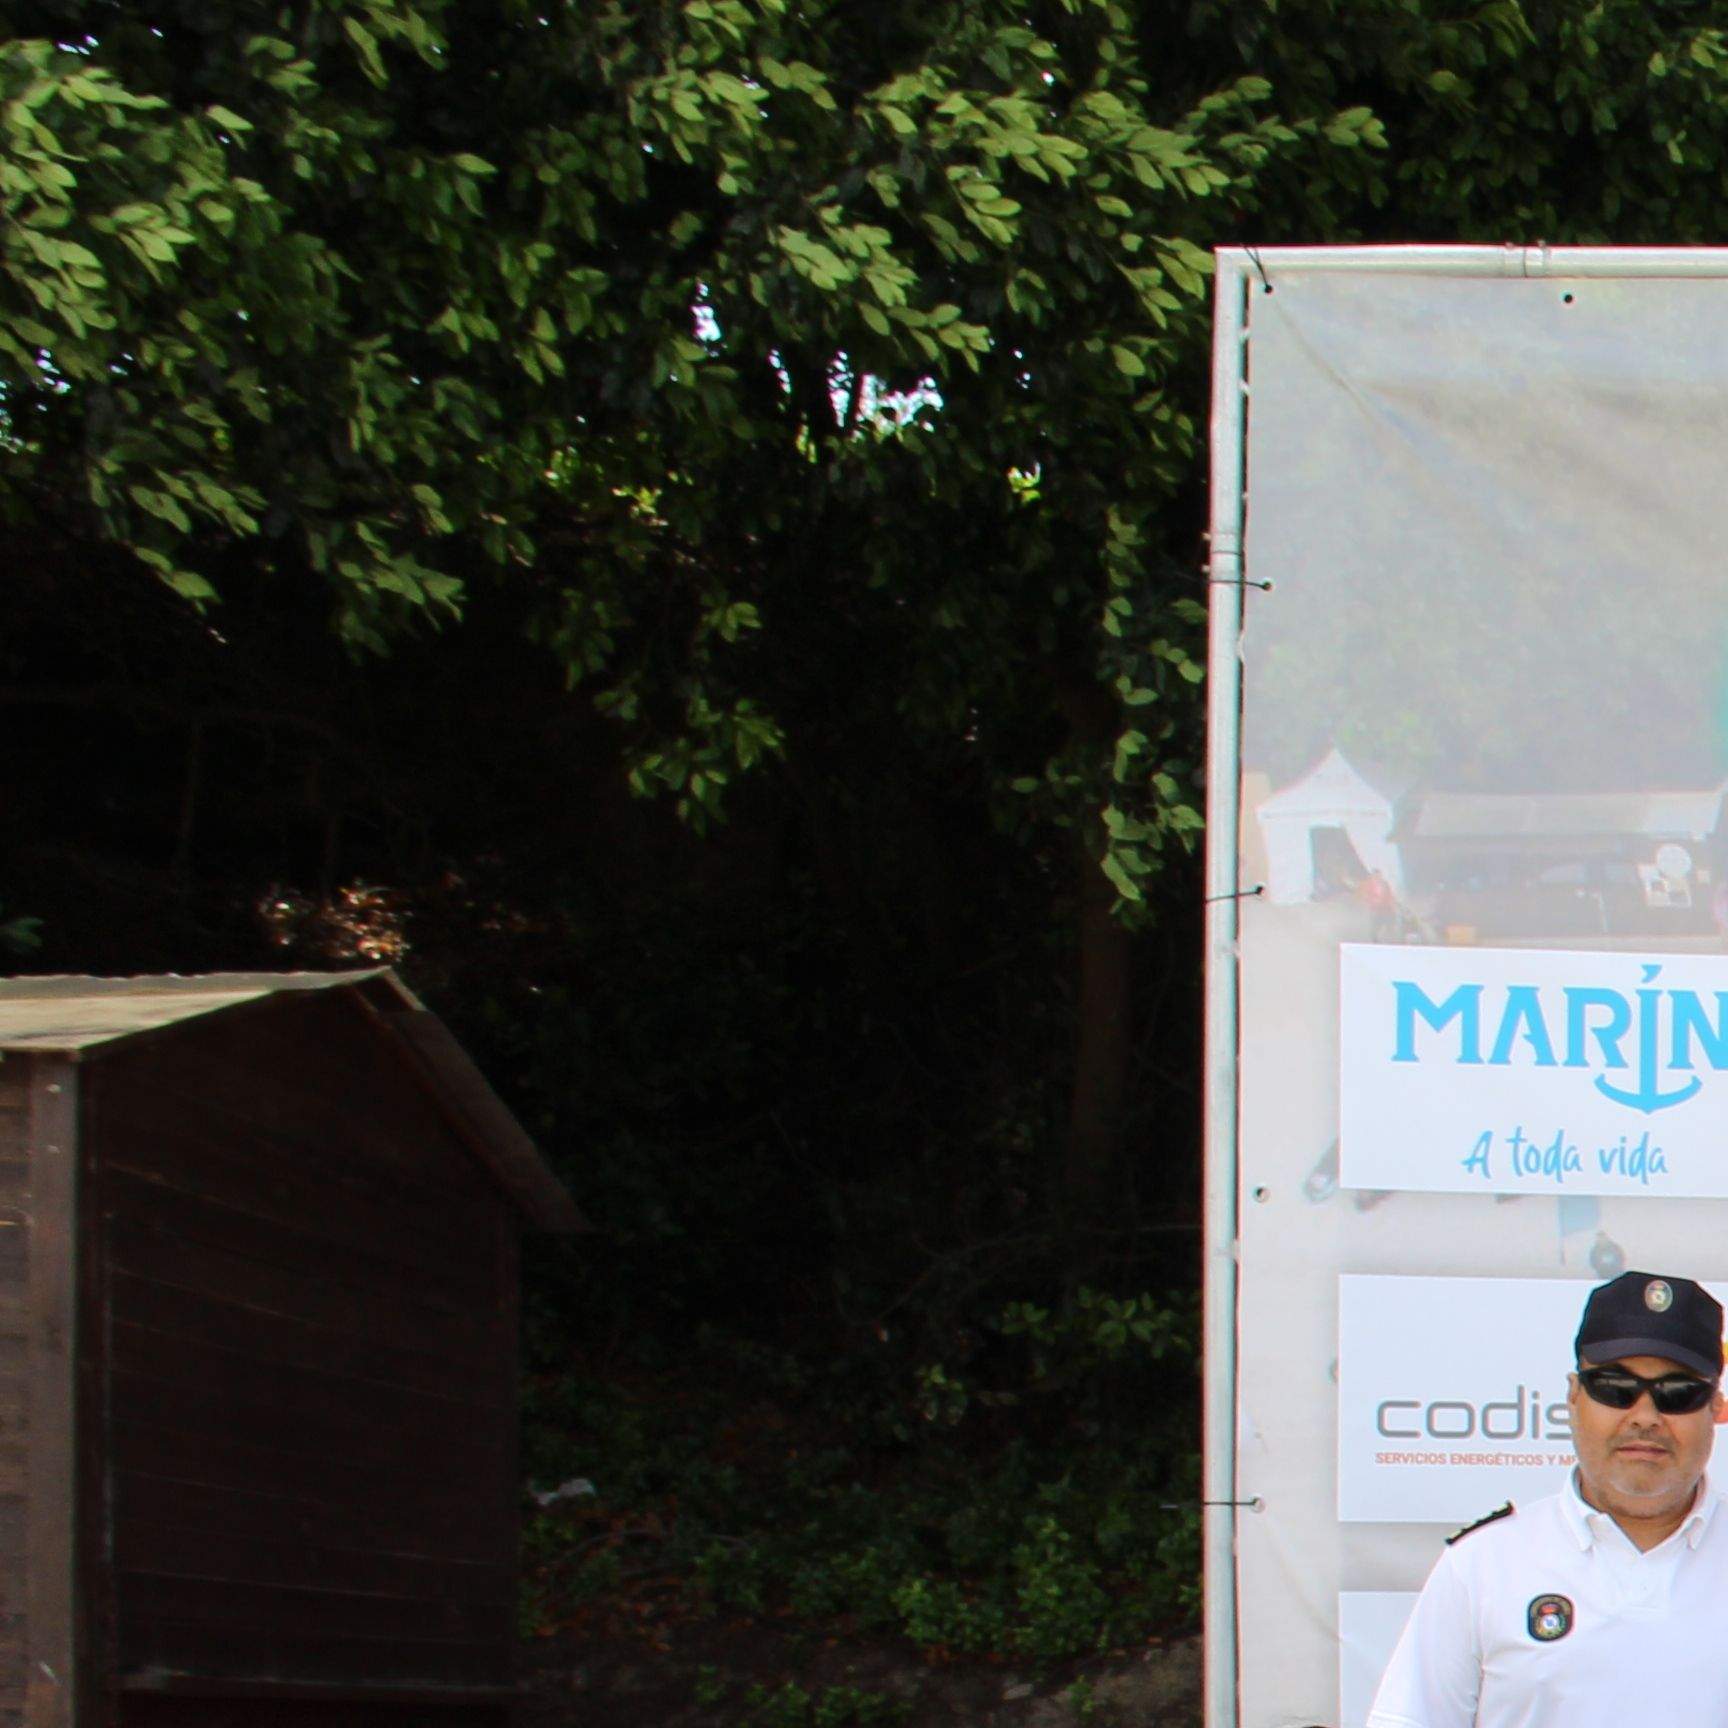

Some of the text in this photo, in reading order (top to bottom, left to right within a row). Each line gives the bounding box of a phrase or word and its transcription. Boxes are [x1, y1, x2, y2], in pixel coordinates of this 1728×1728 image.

[1461, 1125, 1669, 1186] A toda vida
[1375, 1451, 1447, 1466] SERVICIOS
[1449, 1450, 1545, 1467] ENERGÉTICOS
